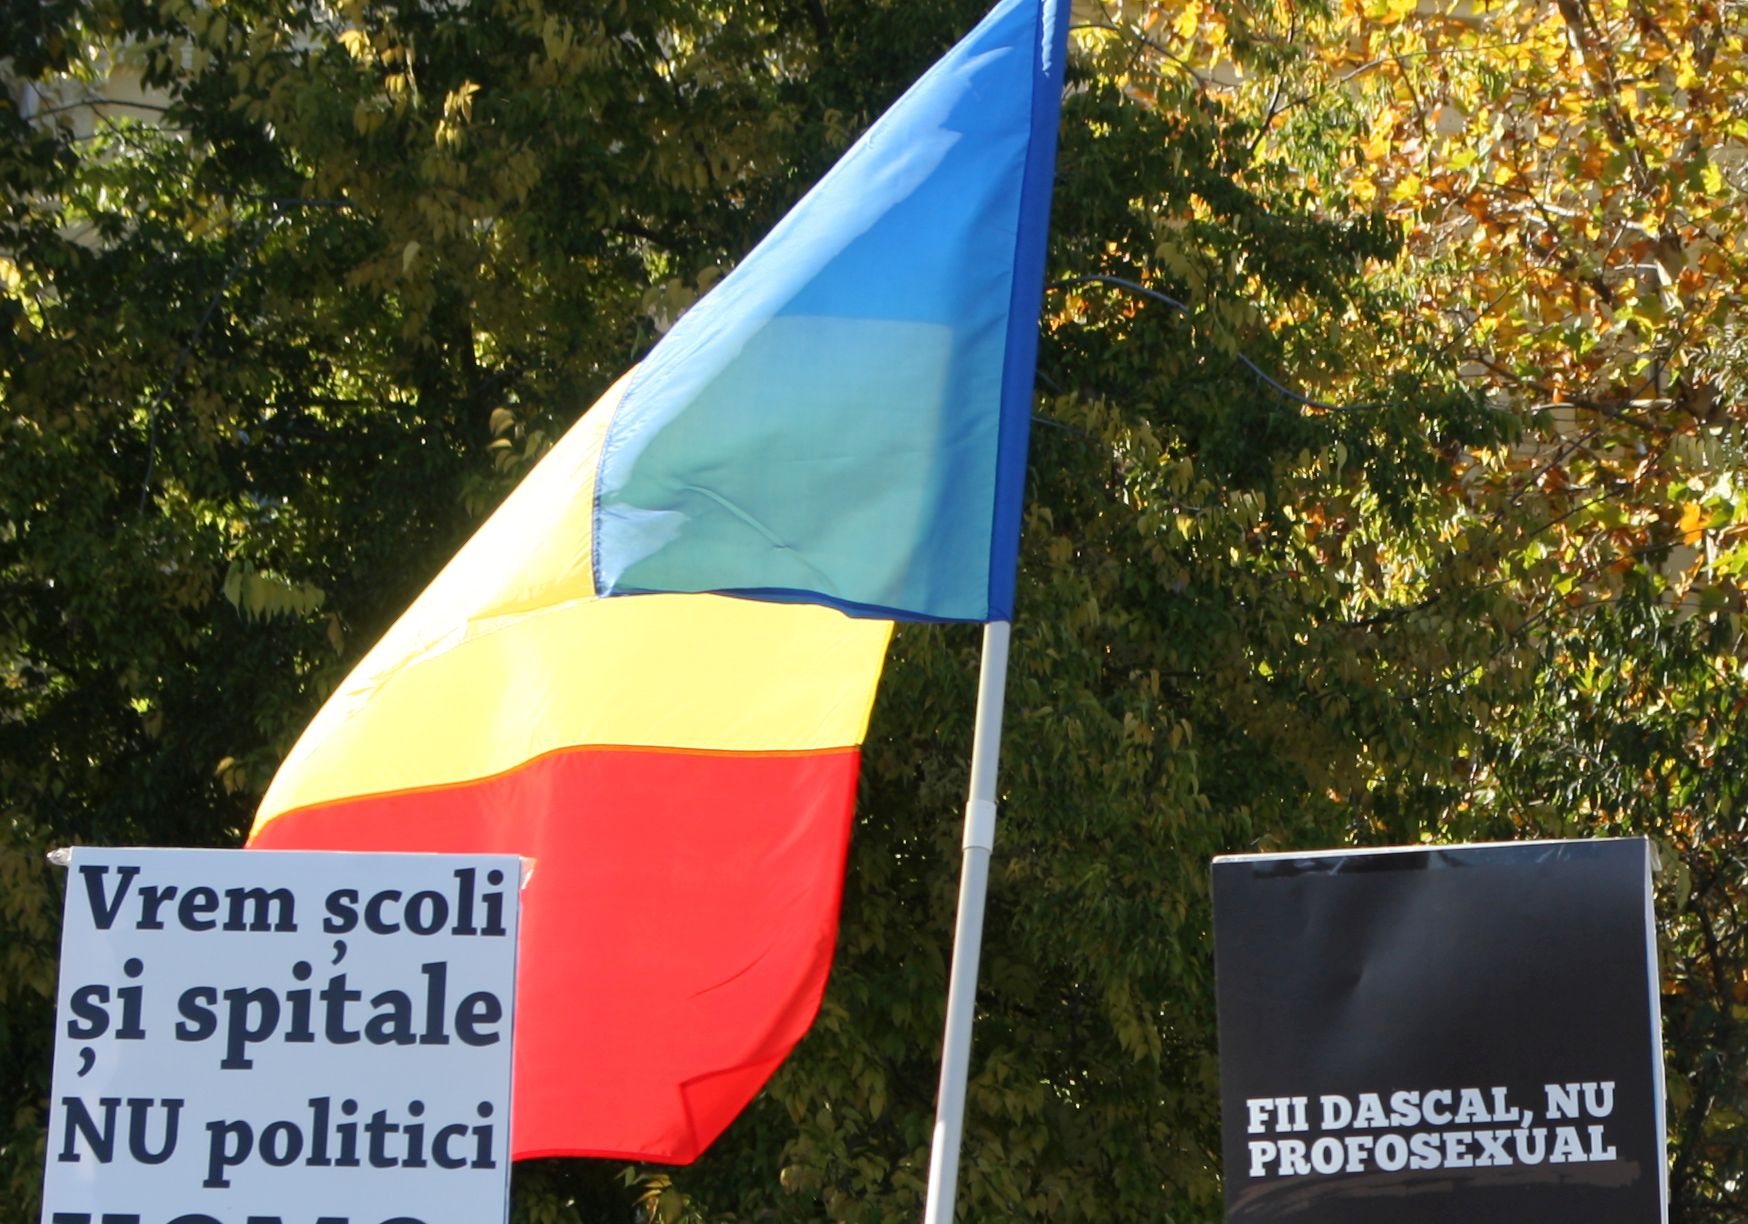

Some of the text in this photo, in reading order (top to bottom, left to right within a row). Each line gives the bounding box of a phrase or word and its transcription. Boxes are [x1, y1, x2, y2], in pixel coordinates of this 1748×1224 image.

[79, 865, 506, 965] Vrem școli
[66, 958, 503, 1077] și spitale
[57, 1096, 497, 1189] NU politici
[1247, 1082, 1615, 1134] FII DASCAL, NU
[1248, 1124, 1616, 1178] PROFOSEXUAL
